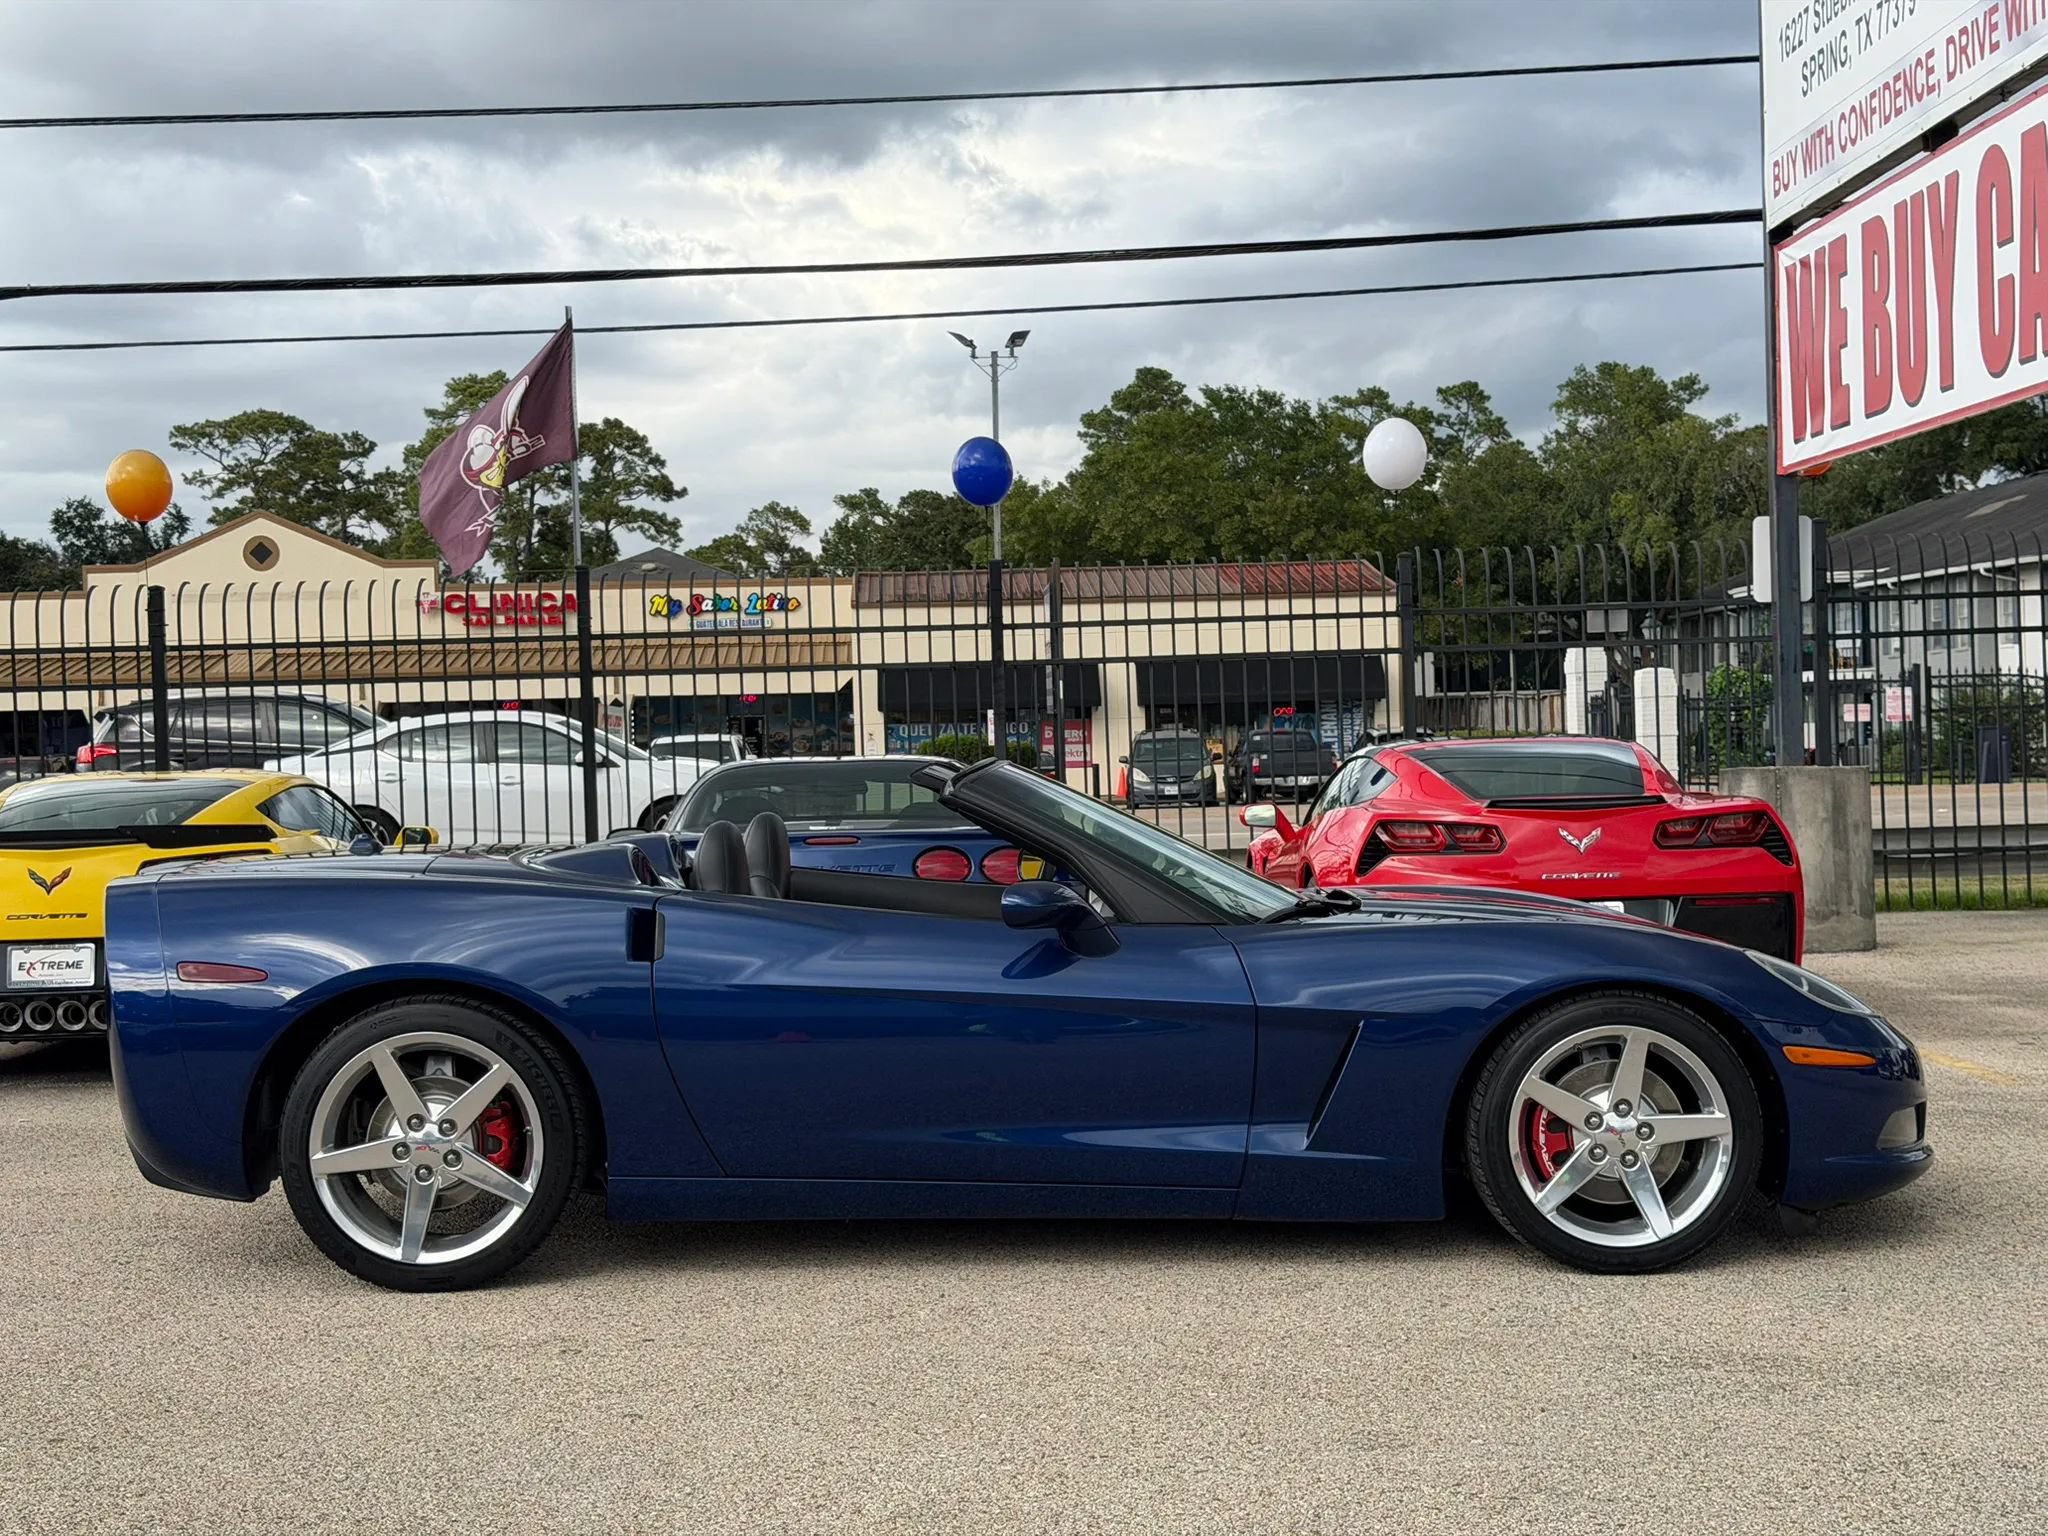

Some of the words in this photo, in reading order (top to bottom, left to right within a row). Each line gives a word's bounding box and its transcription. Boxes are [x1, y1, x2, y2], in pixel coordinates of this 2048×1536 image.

[1779, 5, 1809, 62] 16227
[1801, 29, 1852, 98] SPRING,
[1855, 8, 1873, 55] TX
[1772, 145, 1798, 199] BUY
[1800, 119, 1834, 179] WITH
[1838, 47, 1941, 154] CONFIDENCE,
[1946, 2, 2000, 83] DRIVE
[1785, 232, 1851, 445] WE
[1861, 169, 1960, 420] BUY
[443, 591, 577, 615] CLINICA
[650, 593, 683, 619] My
[686, 593, 741, 616] Sabor
[744, 592, 801, 615] Latino
[1541, 871, 1622, 880] CORVETTE
[6, 912, 89, 921] CORVETTE
[18, 959, 84, 972] EXTREME
